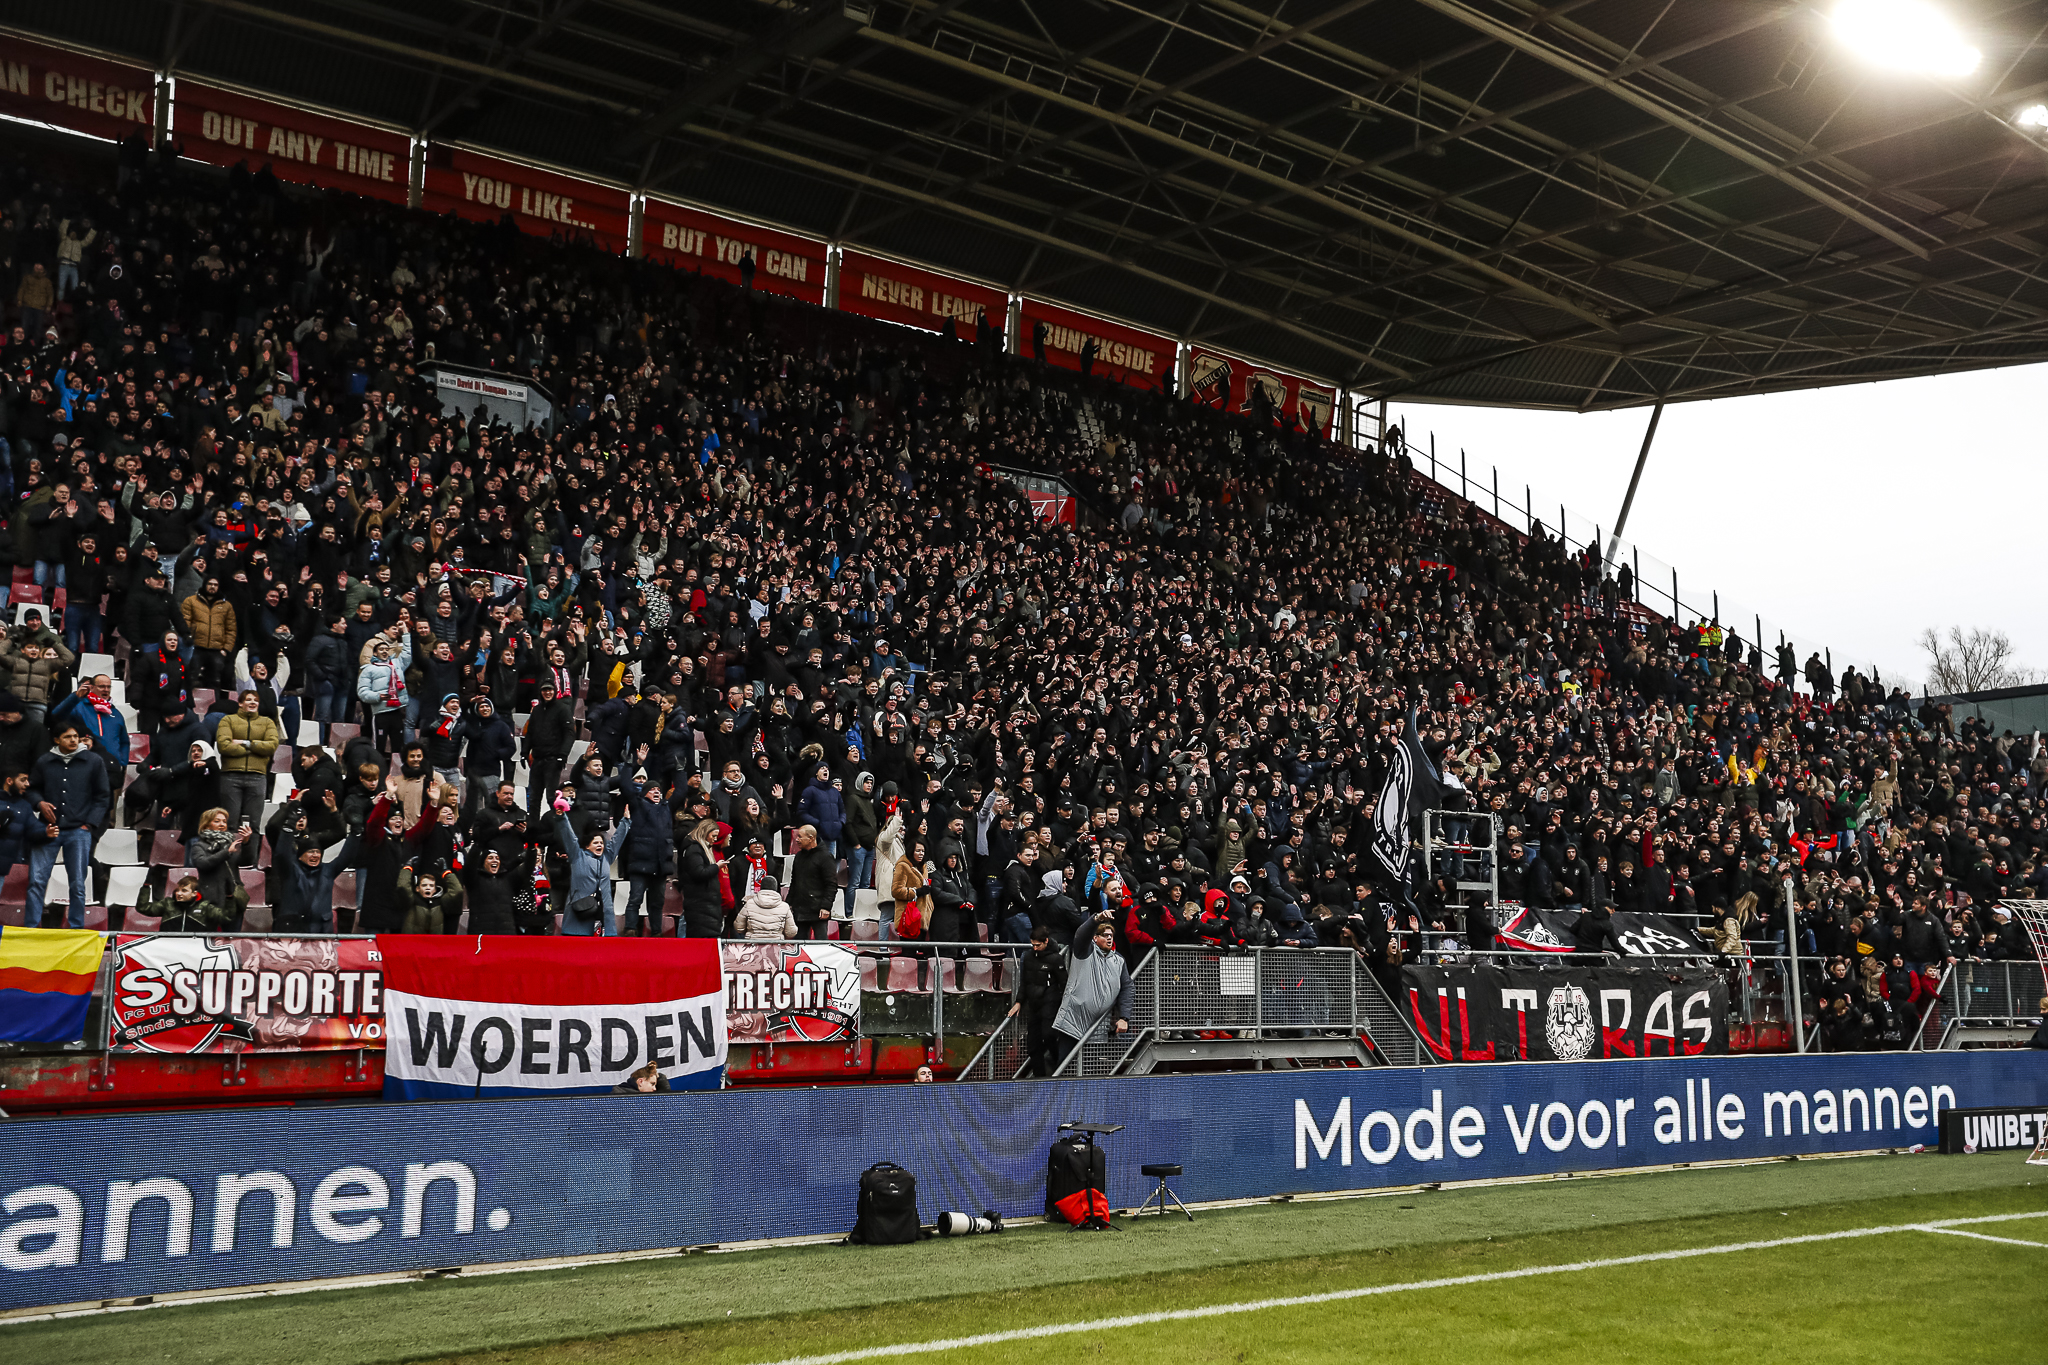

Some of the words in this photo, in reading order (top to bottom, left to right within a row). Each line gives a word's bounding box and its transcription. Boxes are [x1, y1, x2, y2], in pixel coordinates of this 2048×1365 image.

[45, 71, 148, 124] CHECK
[202, 110, 258, 150] OUT
[267, 126, 324, 165] ANY
[334, 141, 395, 182] TIME
[463, 172, 511, 209] YOU
[521, 187, 595, 230] LIKE...
[663, 223, 707, 256] BUT
[765, 250, 807, 282] CAN
[862, 273, 924, 311] NEVER
[1195, 364, 1229, 391] UTRECHT
[124, 1009, 145, 1021] FC
[1554, 994, 1563, 1003] 20
[125, 1018, 176, 1039] Sinds
[821, 1011, 848, 1026] 1981
[404, 1005, 716, 1075] WOERDEN
[1294, 1089, 1486, 1170] Mode
[1503, 1097, 1635, 1155] voor
[1653, 1077, 1746, 1145] alle
[1763, 1083, 1956, 1138] mannen
[1963, 1112, 2047, 1149] UNIBET
